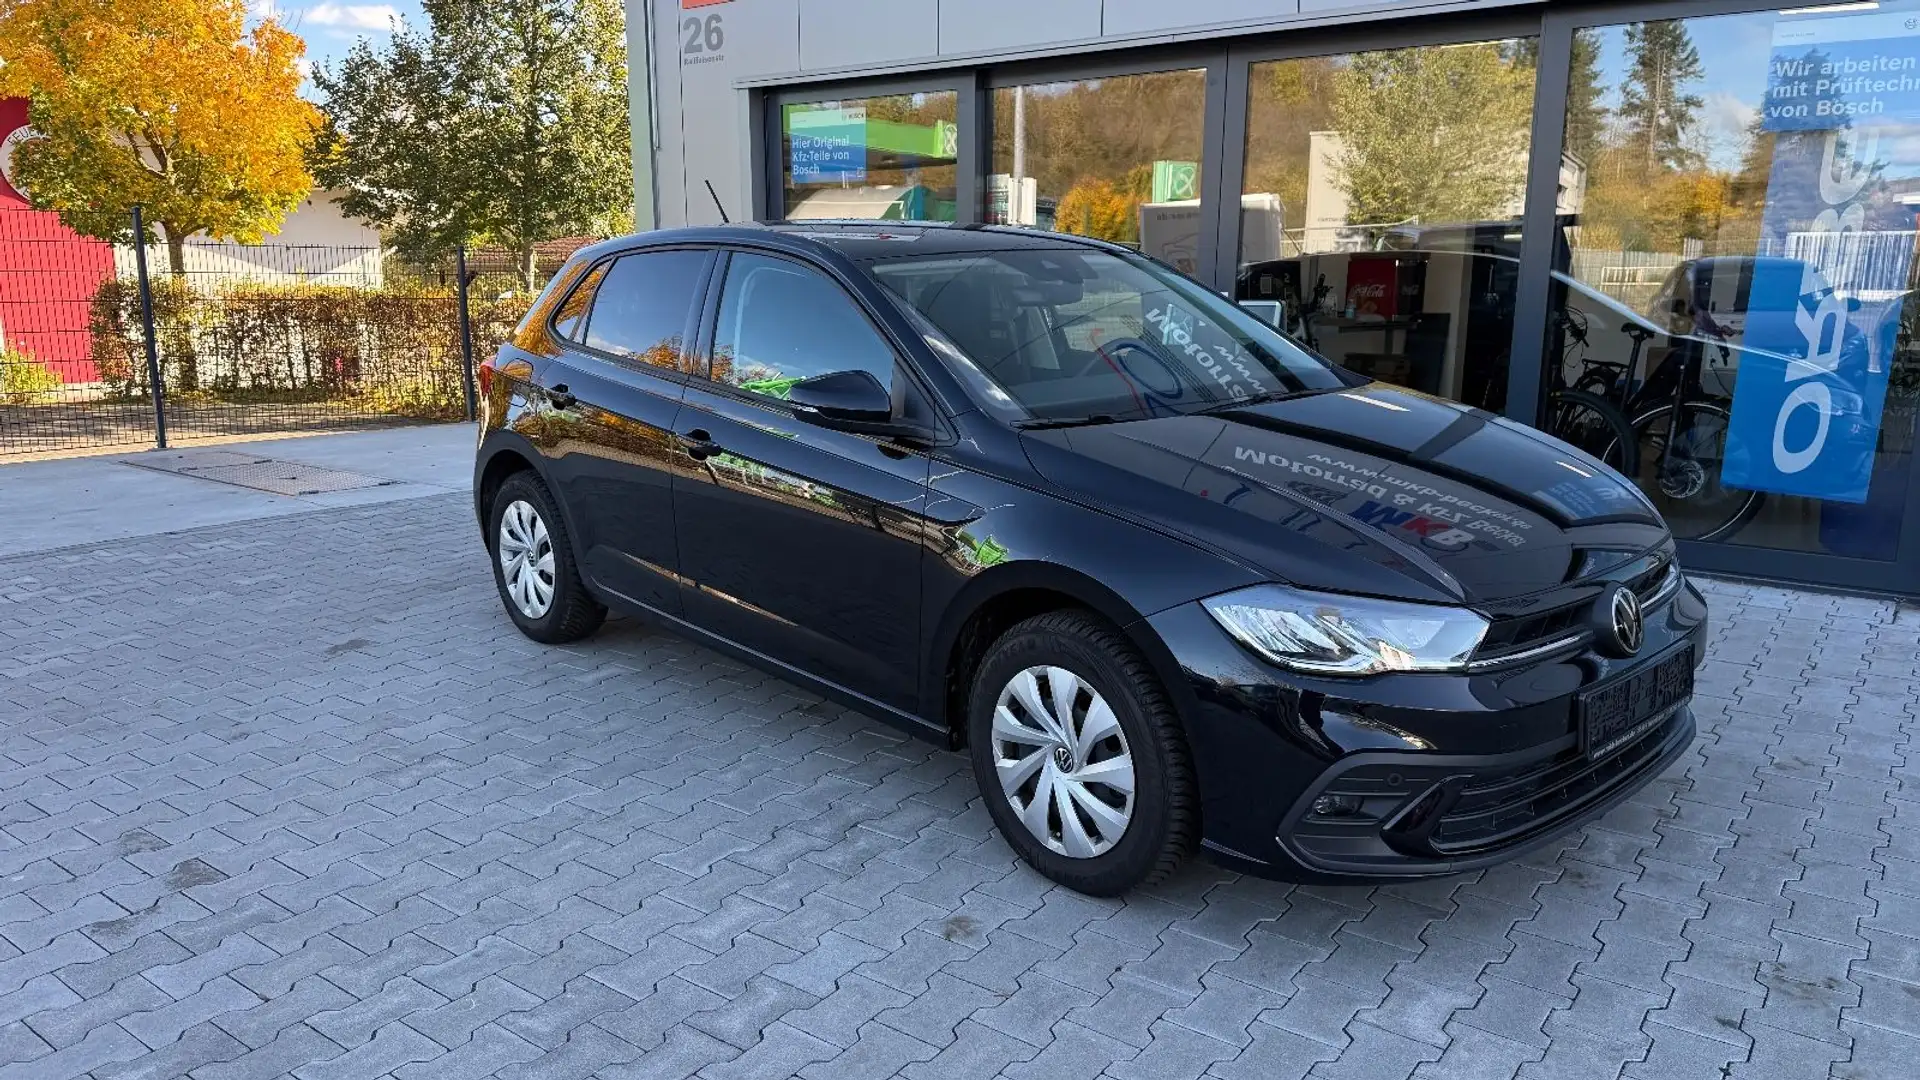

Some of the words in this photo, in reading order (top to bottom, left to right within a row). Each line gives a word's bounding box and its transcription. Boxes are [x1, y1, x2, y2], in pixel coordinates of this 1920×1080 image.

[683, 14, 724, 53] 26
[1776, 60, 1814, 78] Wir
[1820, 55, 1916, 77] arbeiten
[1772, 81, 1809, 98] mit
[1770, 103, 1808, 118] von
[1815, 96, 1884, 117] Bosch
[792, 138, 811, 149] Hier
[813, 134, 850, 149] Original
[793, 150, 831, 162] Kfz-Teile
[833, 151, 850, 160] von
[793, 163, 820, 175] Bosch
